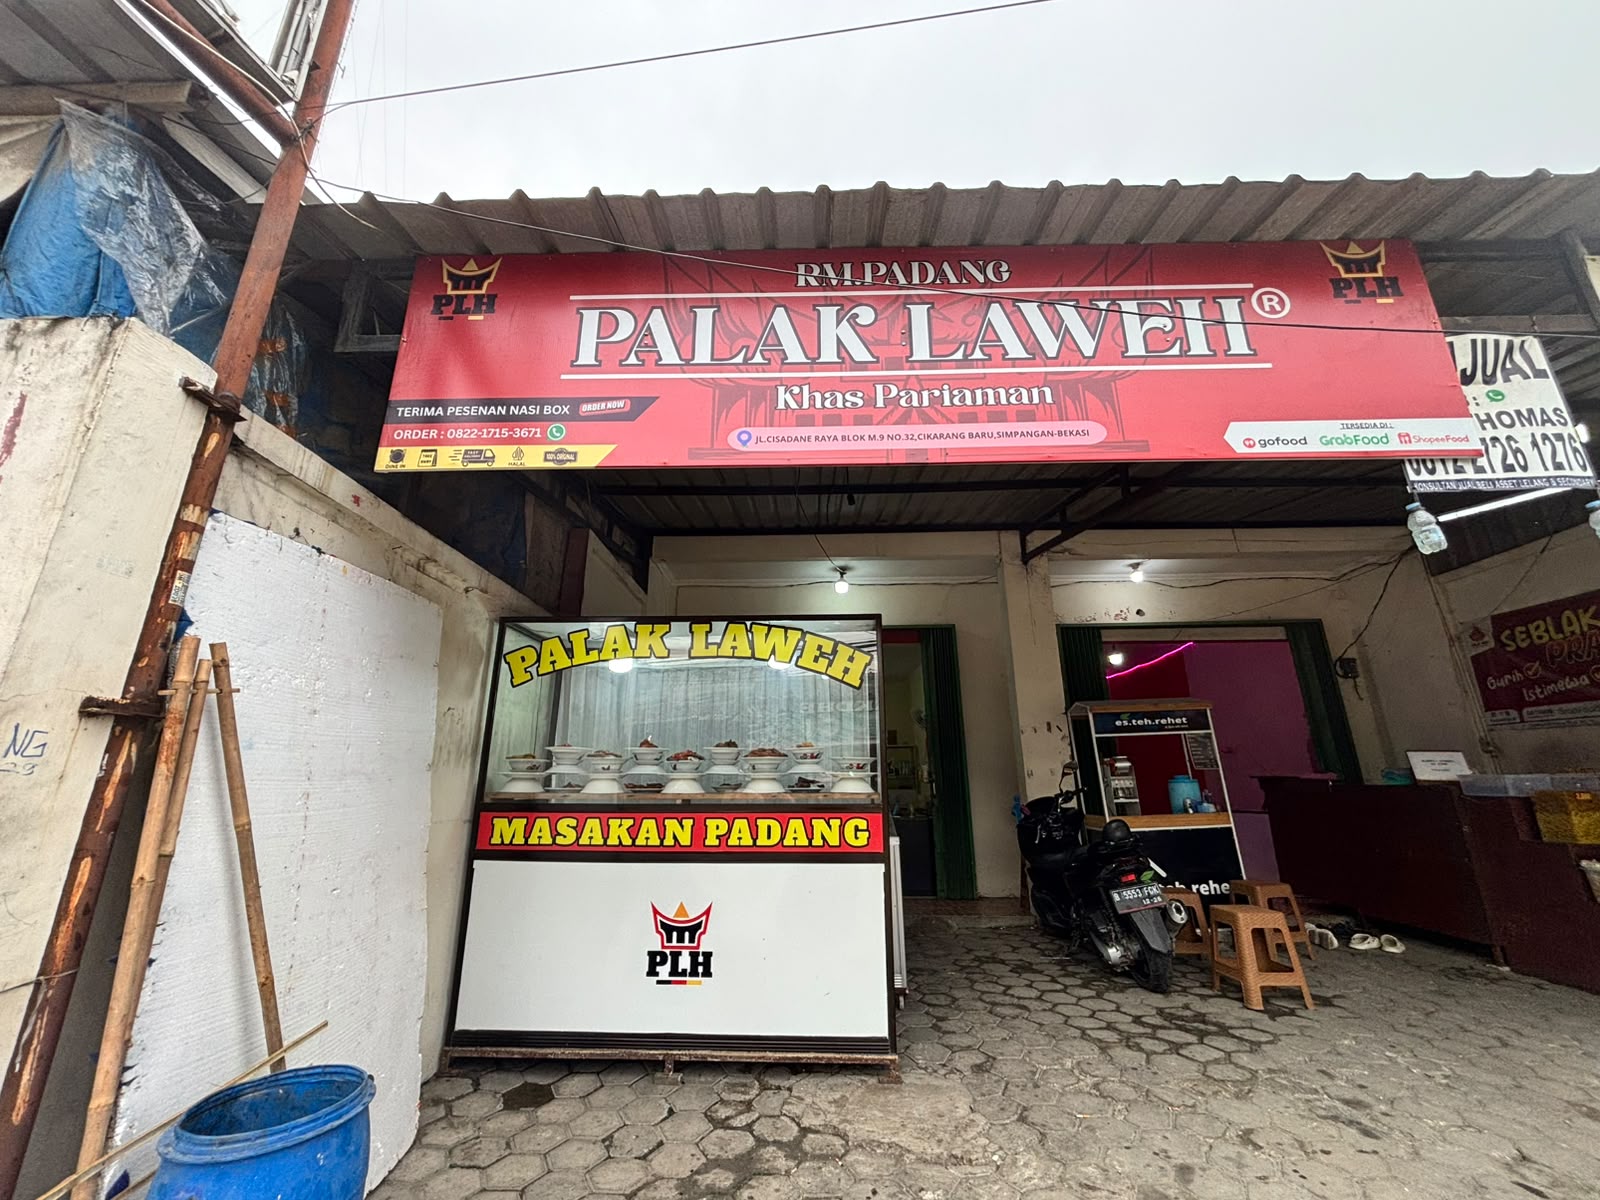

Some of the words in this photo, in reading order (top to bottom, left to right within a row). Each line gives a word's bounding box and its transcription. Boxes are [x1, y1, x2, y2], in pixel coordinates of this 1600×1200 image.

[795, 260, 1012, 288] RM.PADANG
[1328, 276, 1404, 299] PLH
[431, 293, 498, 315] PLH
[571, 303, 880, 368] PALAK
[906, 295, 1257, 363] LAWEH
[581, 402, 607, 412] ORDER
[606, 400, 626, 410] NOW
[775, 383, 864, 411] Khas
[874, 382, 1055, 409] Pariaman
[396, 406, 444, 418] TERIMA
[446, 405, 508, 417] PESENAN
[510, 404, 541, 416] NASI
[546, 404, 570, 415] BOX
[394, 429, 438, 440] ORDER
[447, 427, 542, 440] 0822-1715-3671
[755, 434, 812, 445] JL.CISADANE
[814, 434, 839, 443] RAYA
[841, 433, 866, 443] BLOK
[868, 433, 885, 442] M.9
[1257, 435, 1308, 448] gofood
[1319, 432, 1390, 447] GrabFood
[1413, 434, 1470, 445] ShopeeFood
[1530, 431, 1589, 473] 1276
[1501, 605, 1600, 652] SEBLAK
[503, 622, 671, 687] PALAK
[689, 622, 873, 690] LAWEH
[1487, 669, 1524, 690] Gurih
[1522, 674, 1590, 702] Istimewa
[1114, 715, 1189, 727] es.teh.rehet
[2, 721, 49, 759] NG
[490, 815, 694, 848] MASAKAN
[703, 815, 871, 849] PADANG
[1122, 888, 1143, 900] 5553
[645, 950, 713, 978] PLH
